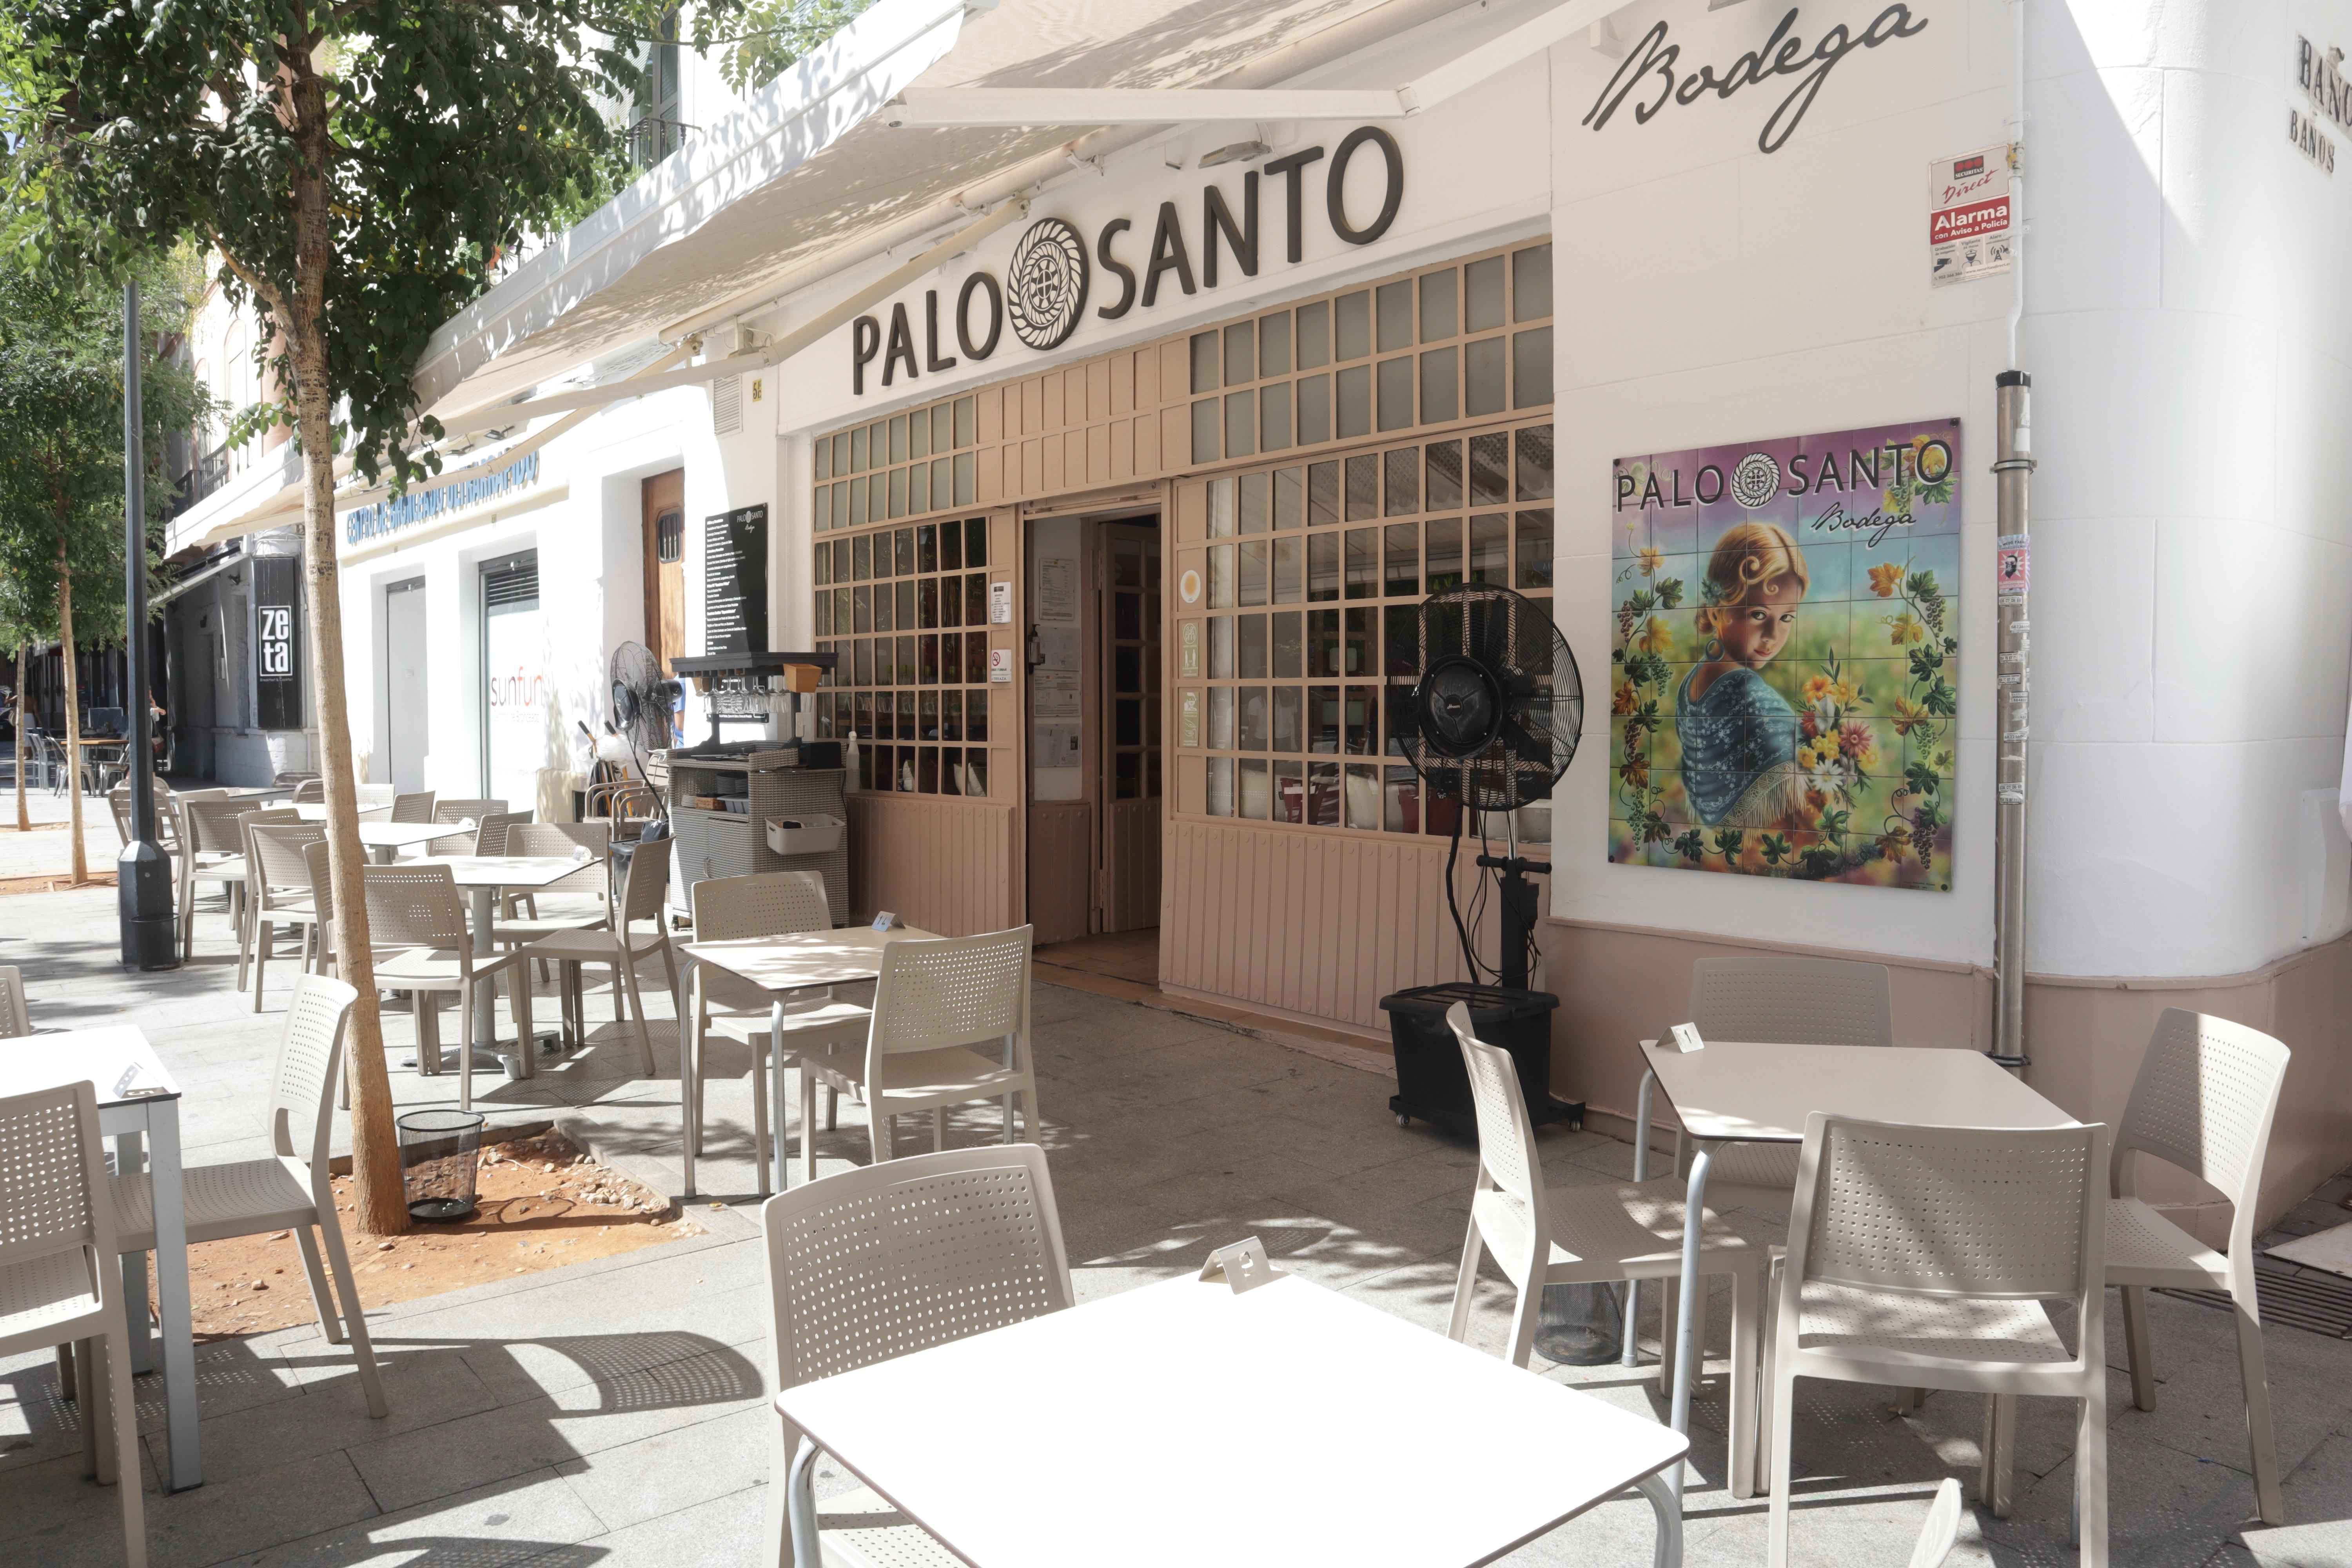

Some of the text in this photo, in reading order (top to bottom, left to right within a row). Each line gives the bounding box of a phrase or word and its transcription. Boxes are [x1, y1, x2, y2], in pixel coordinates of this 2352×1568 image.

[1582, 3, 1929, 153] Bodega
[1942, 168, 2000, 204] Direct
[1955, 167, 1983, 178] SECURITAS
[1935, 205, 2007, 231] Alarma
[1950, 228, 1972, 237] Aviso
[1982, 219, 2007, 230] Policía
[852, 125, 1404, 395] PALO SANTO
[1616, 439, 1953, 513] PALO SANTO
[1811, 501, 1917, 549] Bodega
[491, 666, 543, 706] sunfun
